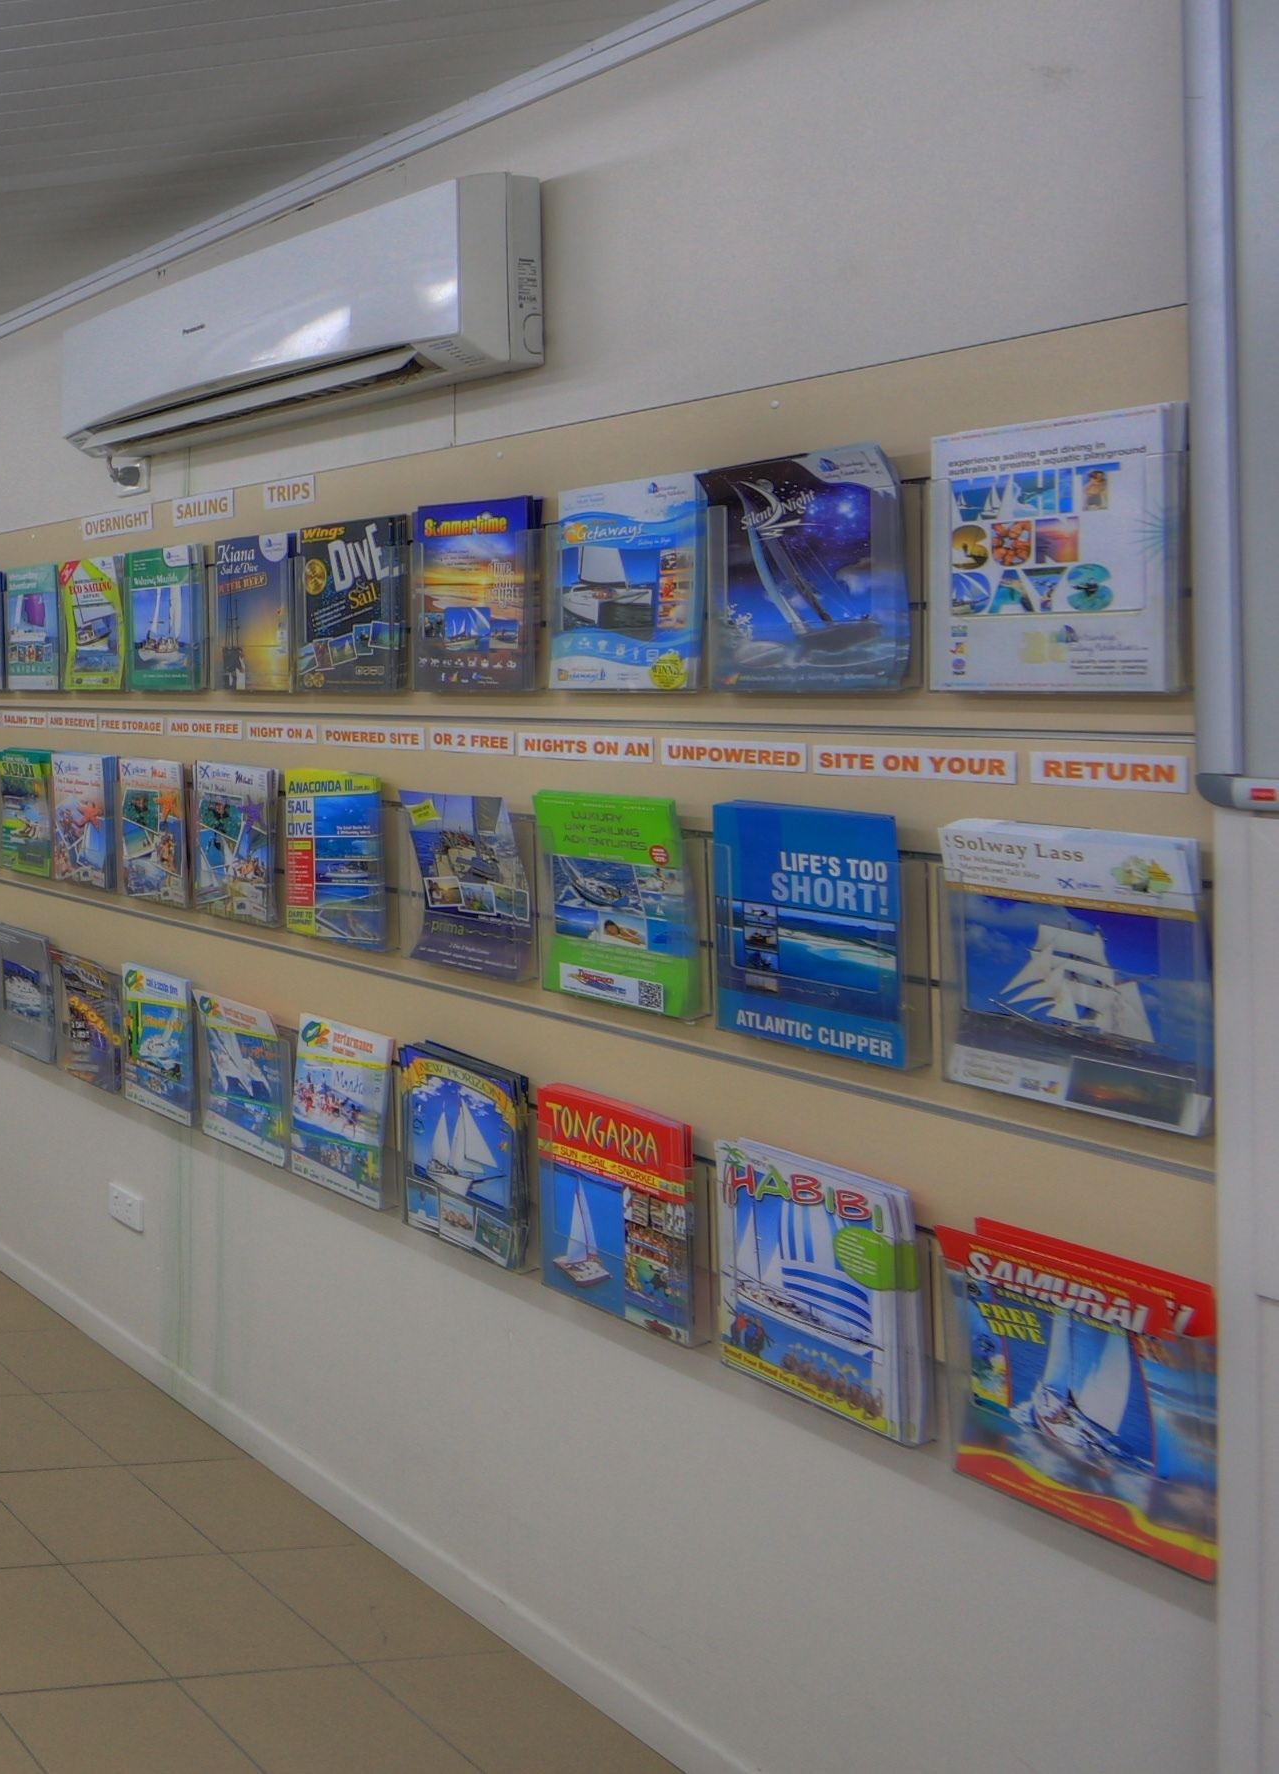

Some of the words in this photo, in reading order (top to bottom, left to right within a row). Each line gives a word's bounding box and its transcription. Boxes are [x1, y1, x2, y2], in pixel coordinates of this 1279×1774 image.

[948, 453, 1001, 469] experience
[1003, 449, 1036, 462] sailing
[1038, 446, 1058, 457] and
[1060, 443, 1093, 455] diving
[1095, 440, 1106, 450] in
[948, 461, 997, 477] australia's
[999, 457, 1041, 472] greatest
[1043, 453, 1082, 467] aquatic
[1084, 444, 1147, 462] playground
[951, 461, 1121, 522] WHIT
[84, 511, 149, 536] OVERNIGHT
[176, 496, 229, 520] SAILING
[267, 482, 311, 503] TRIPS
[741, 506, 774, 530] Silent
[780, 489, 816, 515] Night
[301, 526, 346, 542] Wings
[424, 516, 508, 537] Summertime
[575, 522, 643, 544] Getaways
[217, 543, 255, 565] Kiana
[951, 516, 1080, 570] SUN
[220, 565, 233, 576] Sail
[242, 562, 258, 573] Dive
[327, 523, 390, 592] DIVE
[69, 584, 83, 595] ECO
[84, 581, 112, 594] SAILING
[348, 582, 379, 609] Sail
[355, 579, 369, 593] &
[951, 562, 1114, 617] DAYS
[4, 715, 28, 724] SAILING
[29, 716, 44, 725] TRIP
[50, 717, 63, 726] AND
[64, 717, 95, 728] RECEIVE
[101, 719, 120, 729] FREE
[121, 720, 161, 732] STORAGE
[170, 722, 189, 733] AND
[191, 722, 212, 733] ONE
[214, 723, 239, 734] FREE
[250, 725, 283, 739] NIGHT
[286, 727, 303, 739] ON
[304, 728, 314, 740] A
[325, 730, 386, 744] POWERED
[389, 731, 419, 745] SITE
[433, 732, 452, 745] OR
[456, 733, 466, 746] 2
[470, 735, 509, 749] FREE
[524, 738, 587, 754] NIGHTS
[593, 741, 619, 756] ON
[624, 742, 650, 757] AN
[667, 745, 802, 767] UNPOWERED
[819, 752, 874, 770] SITE
[882, 754, 920, 772] ON
[928, 756, 1006, 776] YOUR
[1043, 760, 1175, 783] RETURN
[1, 762, 35, 778] SAFARI
[288, 780, 341, 793] ANACONDA
[287, 799, 312, 814] SAIL
[571, 811, 623, 822] LUXURY
[287, 822, 313, 836] DIVE
[591, 825, 640, 838] SAILING
[563, 835, 648, 851] ADVENTURES
[953, 834, 1028, 859] Solway
[1034, 843, 1085, 863] Lass
[780, 851, 841, 877] LIFE'S
[846, 858, 889, 883] TOO
[771, 872, 889, 916] SHORT!
[431, 919, 466, 935] prima
[333, 1031, 374, 1054] performance
[736, 1008, 813, 1042] ATLANTIC
[817, 1025, 894, 1060] CLIPPER
[420, 1061, 444, 1074] NEW
[447, 1065, 506, 1104] HORIZON
[545, 1101, 660, 1168] TONGARRA
[560, 1147, 578, 1158] SUN
[588, 1157, 608, 1170] SAIL
[617, 1165, 658, 1187] SNORKEL
[723, 1163, 883, 1232] HABIBI
[967, 1251, 1150, 1335] SAMURAI
[977, 1301, 1041, 1328] FREE
[988, 1319, 1045, 1345] DIVE
